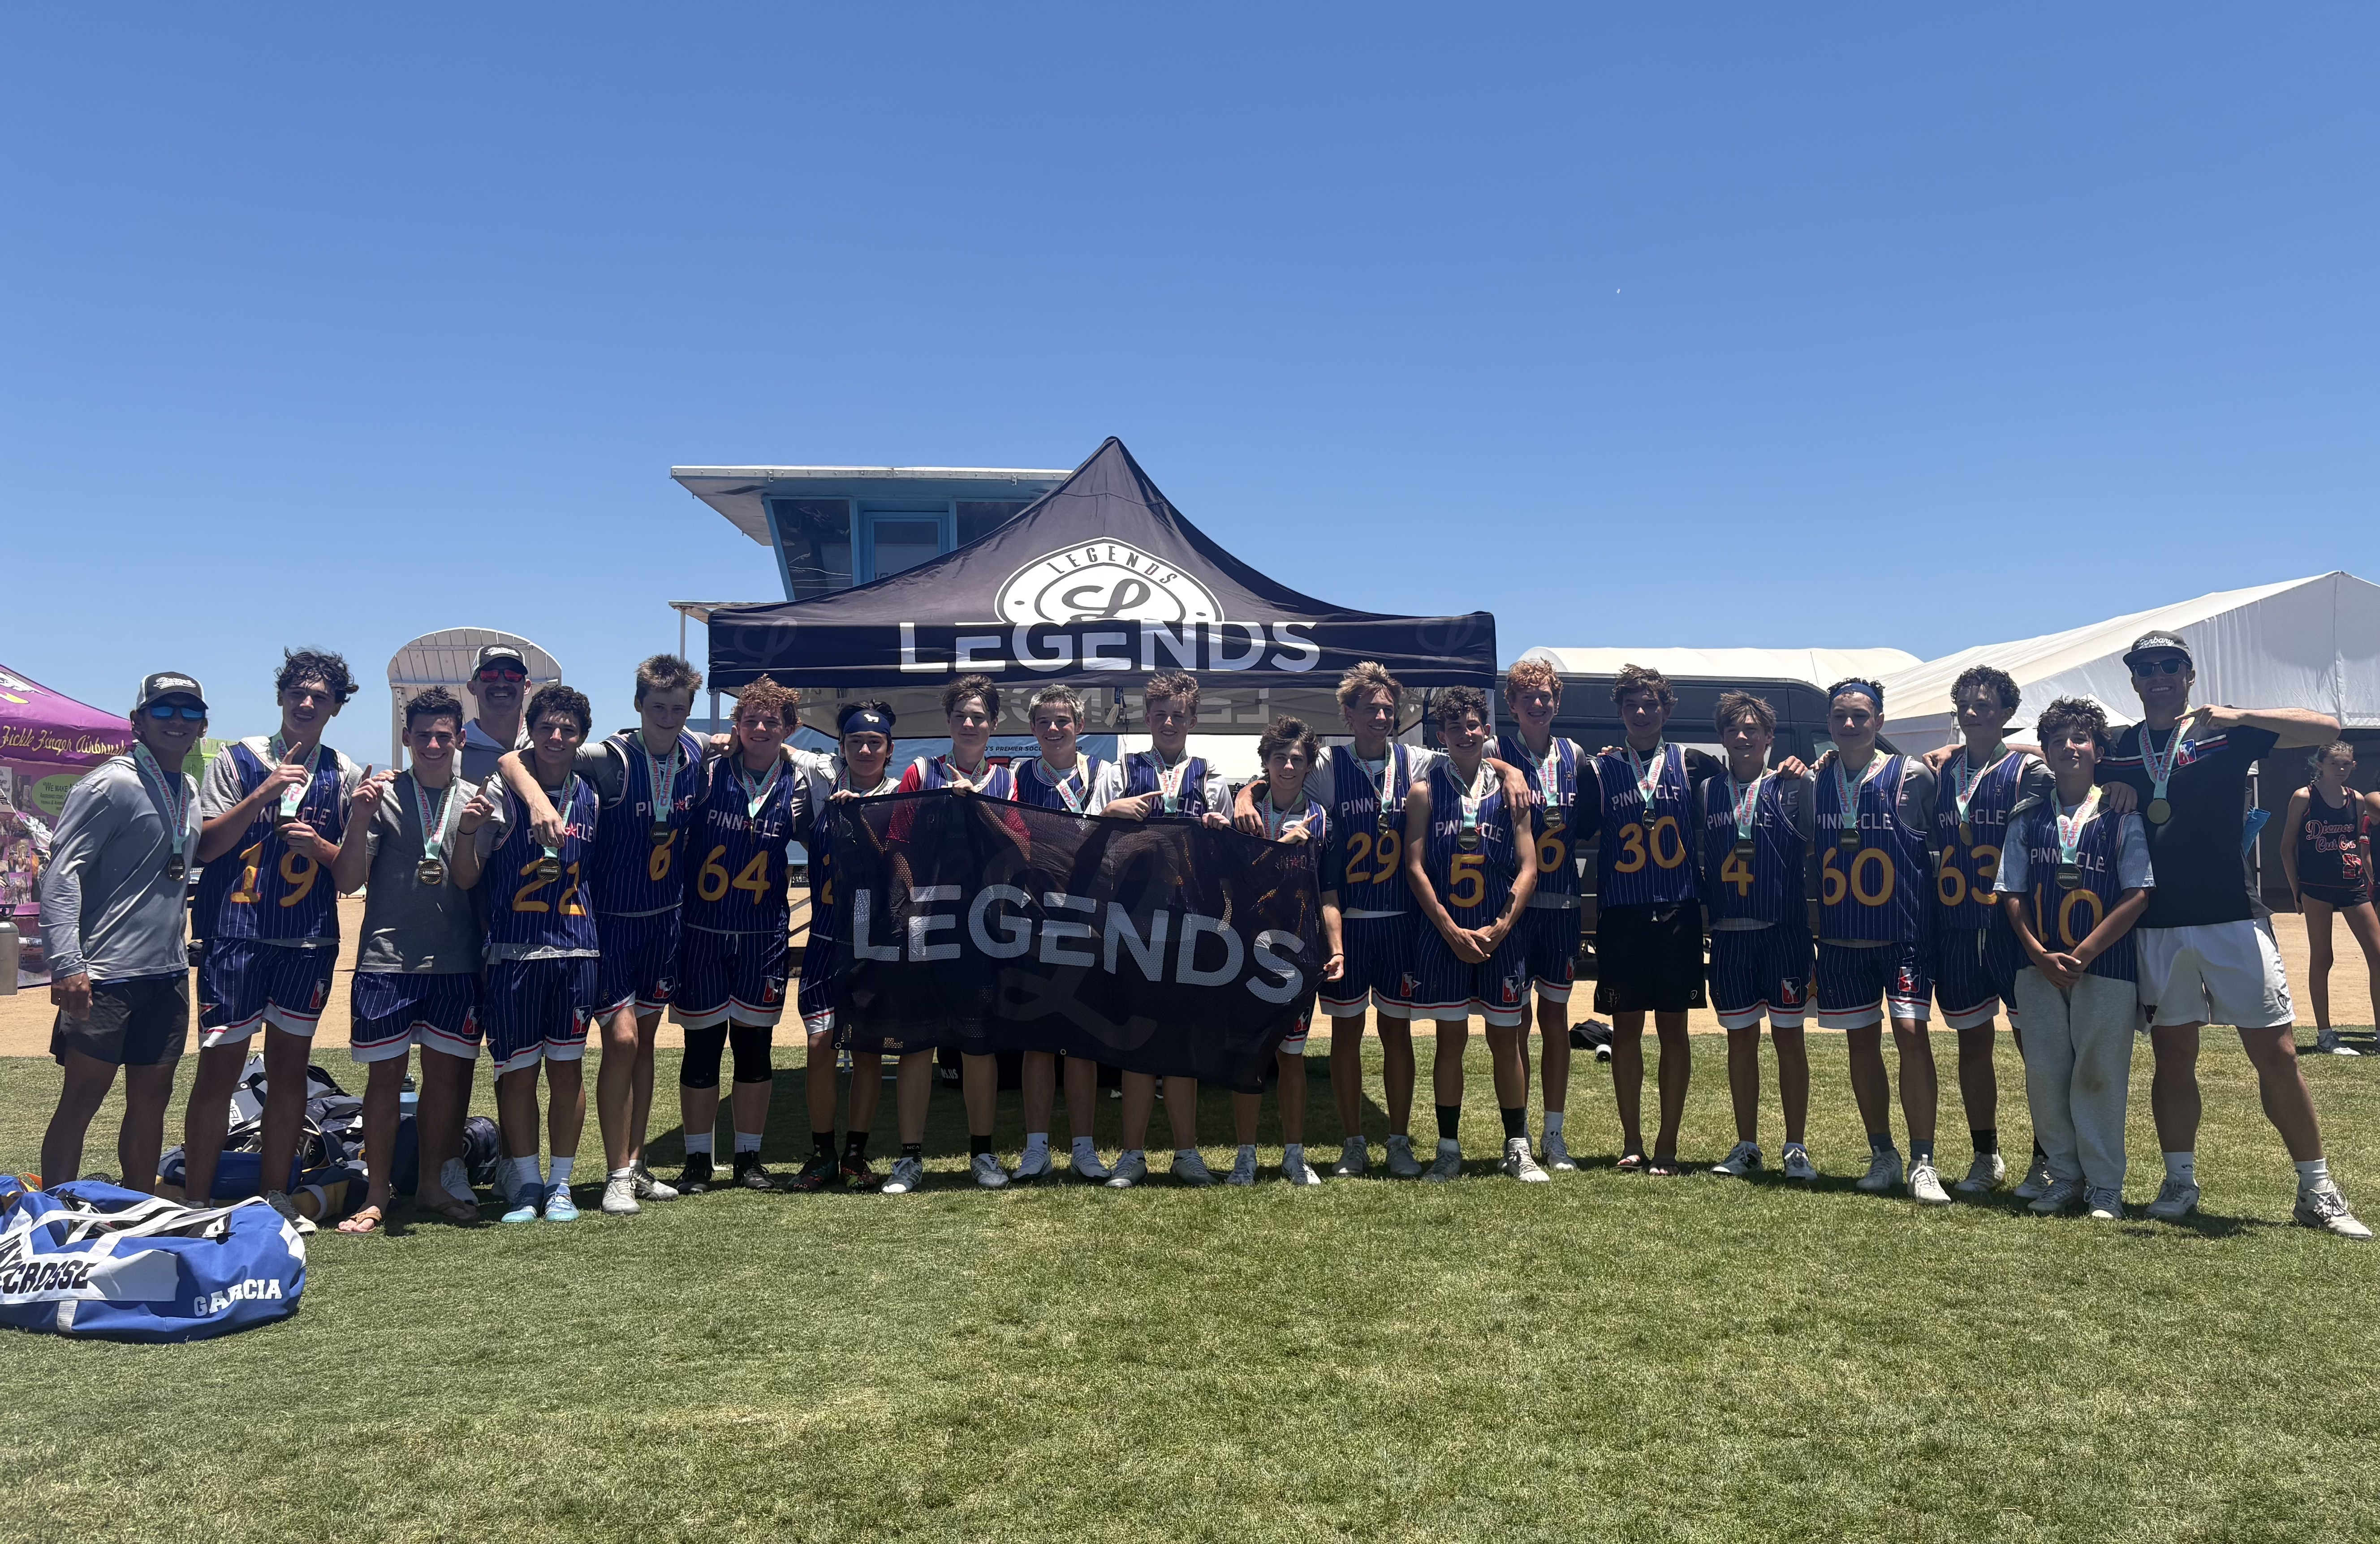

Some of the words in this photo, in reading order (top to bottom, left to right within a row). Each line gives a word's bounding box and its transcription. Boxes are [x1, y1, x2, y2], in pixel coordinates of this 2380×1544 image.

[1046, 546, 1177, 584] LEGENDS
[899, 619, 1320, 672] LEGENDS
[0, 725, 34, 748] Fickle
[32, 730, 72, 756] Finger
[76, 735, 126, 756] Airbrush
[1614, 816, 1686, 873] 30
[2067, 793, 2095, 847] CHAMPIONS
[230, 842, 319, 907] 19
[697, 844, 771, 905] 64
[1345, 829, 1401, 884] 29
[1449, 853, 1485, 908] 5
[1721, 847, 1755, 896] 4
[1822, 847, 1895, 907] 60
[1938, 844, 2002, 907] 63
[2034, 882, 2103, 947] 10
[854, 884, 1306, 1004] LEGENDS
[2, 1260, 98, 1294] CROSSE
[194, 1279, 282, 1316] GARCIA
